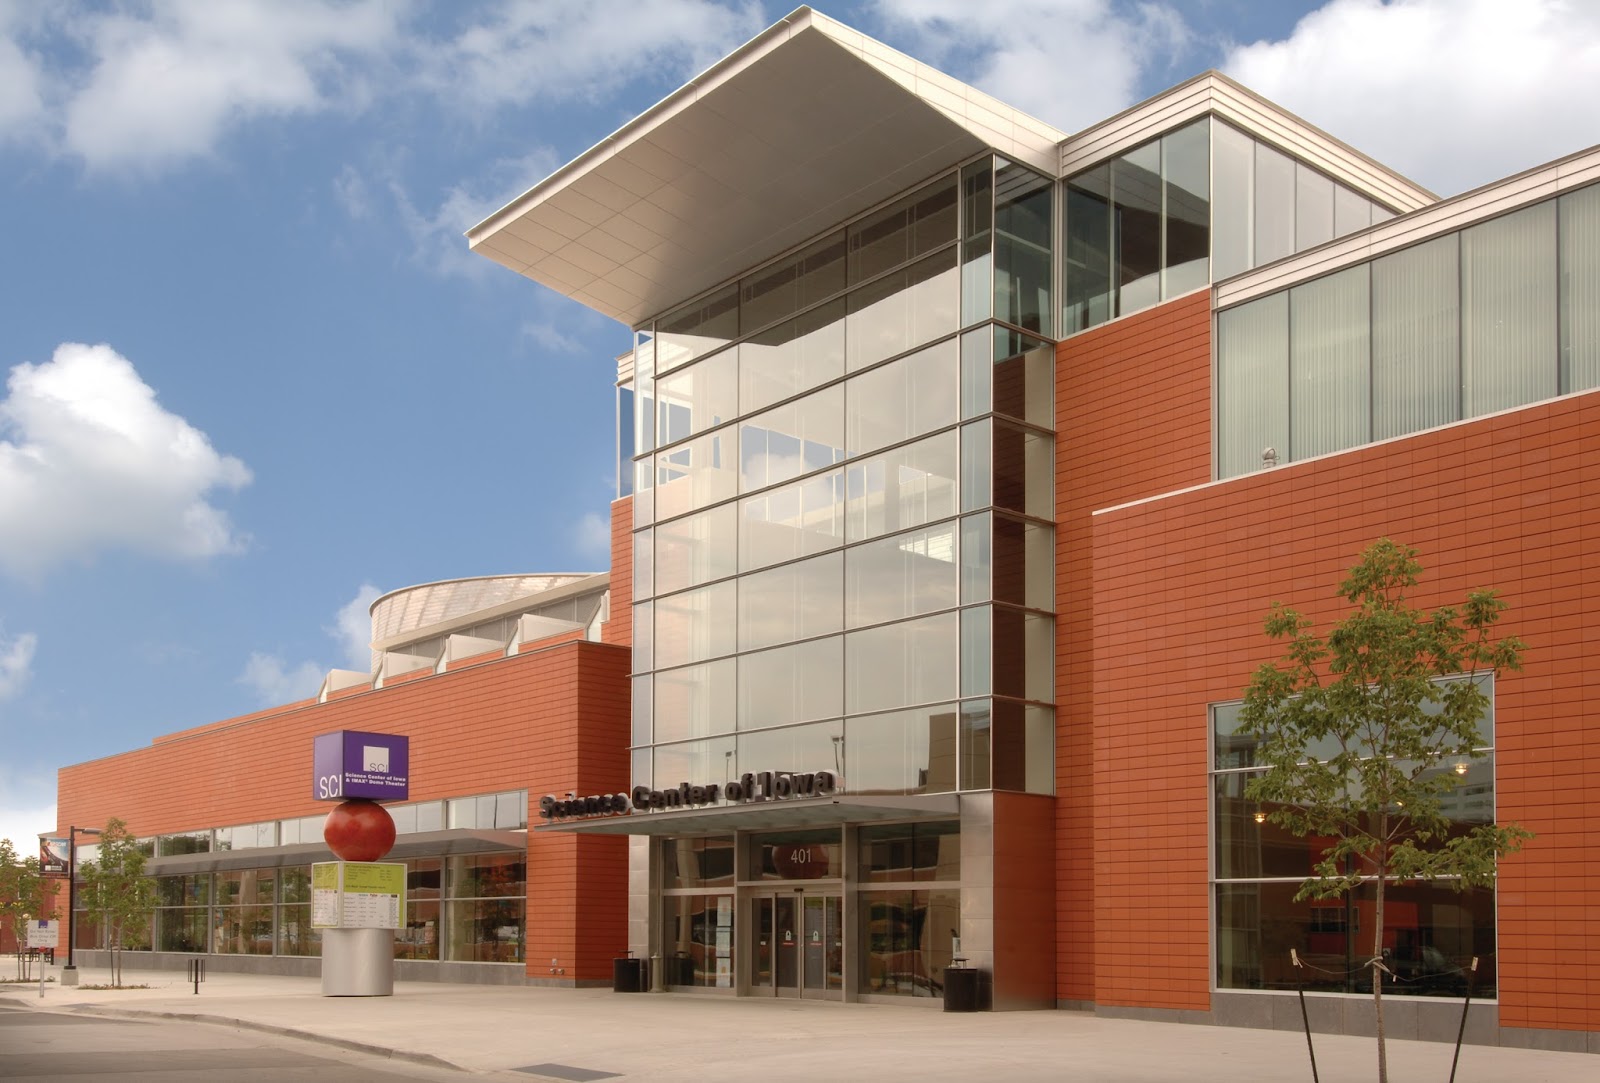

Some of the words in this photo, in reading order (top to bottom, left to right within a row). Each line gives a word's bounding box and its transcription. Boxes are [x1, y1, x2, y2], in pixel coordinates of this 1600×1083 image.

[369, 763, 389, 773] SCI
[320, 774, 342, 799] SCI
[539, 793, 630, 820] Science
[631, 783, 718, 810] Center
[725, 773, 753, 800] of
[756, 771, 835, 799] Iowa
[790, 848, 811, 864] 401
